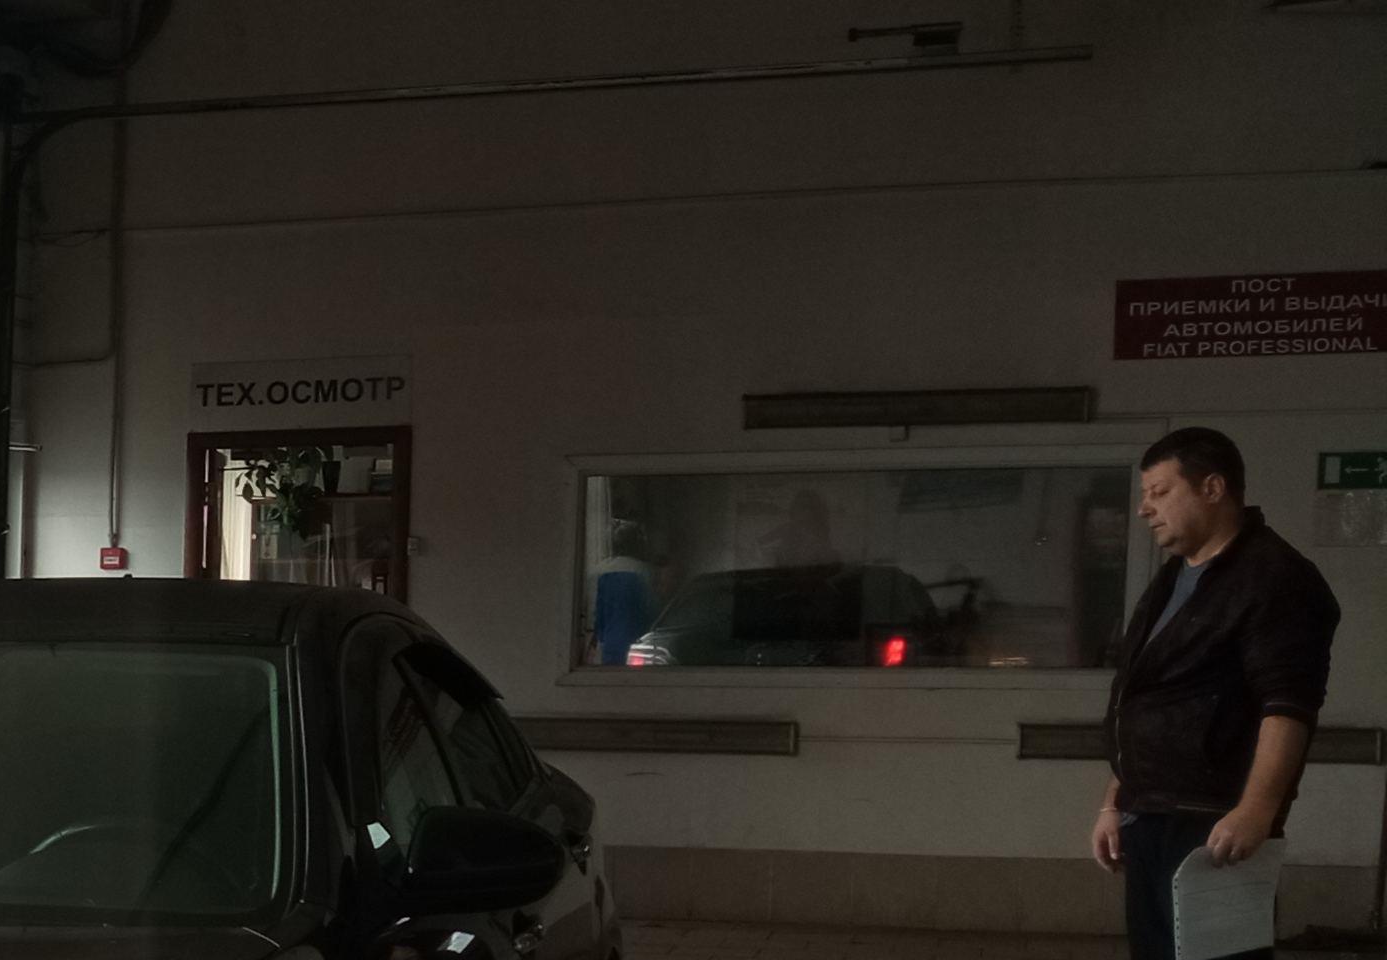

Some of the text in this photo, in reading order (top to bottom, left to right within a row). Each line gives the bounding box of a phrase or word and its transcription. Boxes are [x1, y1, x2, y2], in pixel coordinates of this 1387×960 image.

[1231, 277, 1296, 293] ПОСТ
[1129, 298, 1251, 317] ПРИЕМКИ
[1259, 297, 1276, 312] И
[1163, 313, 1364, 337] АВТОМОБИЛЕЙ
[1142, 336, 1378, 357] FIAT PROFESSIONAL
[195, 376, 406, 407] ТЕХ.ОСМОТР
